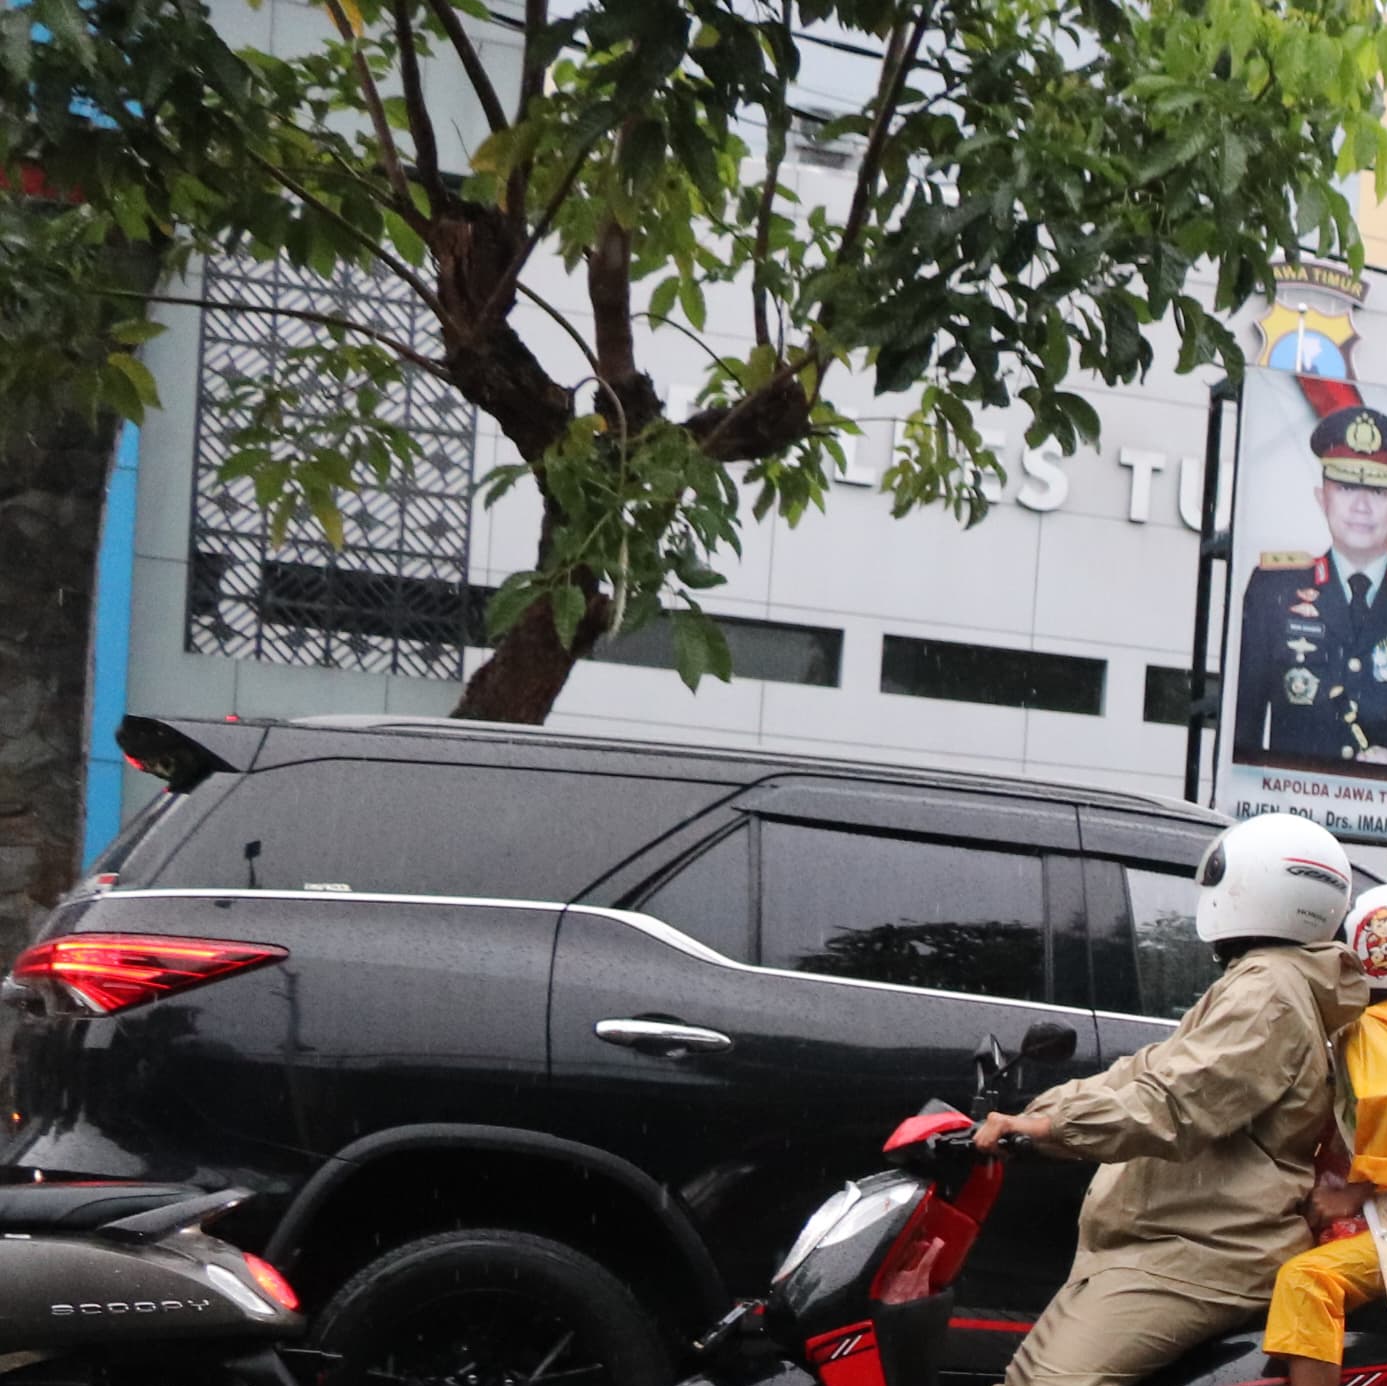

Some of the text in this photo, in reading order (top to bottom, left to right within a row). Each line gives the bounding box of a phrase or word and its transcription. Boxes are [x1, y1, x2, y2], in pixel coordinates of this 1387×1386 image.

[1271, 263, 1309, 281] AWA
[1261, 776, 1329, 798] KAPOLDA
[1334, 785, 1374, 802] JAWA
[1326, 811, 1352, 830] Drs.
[51, 1298, 210, 1315] SCOOPY
